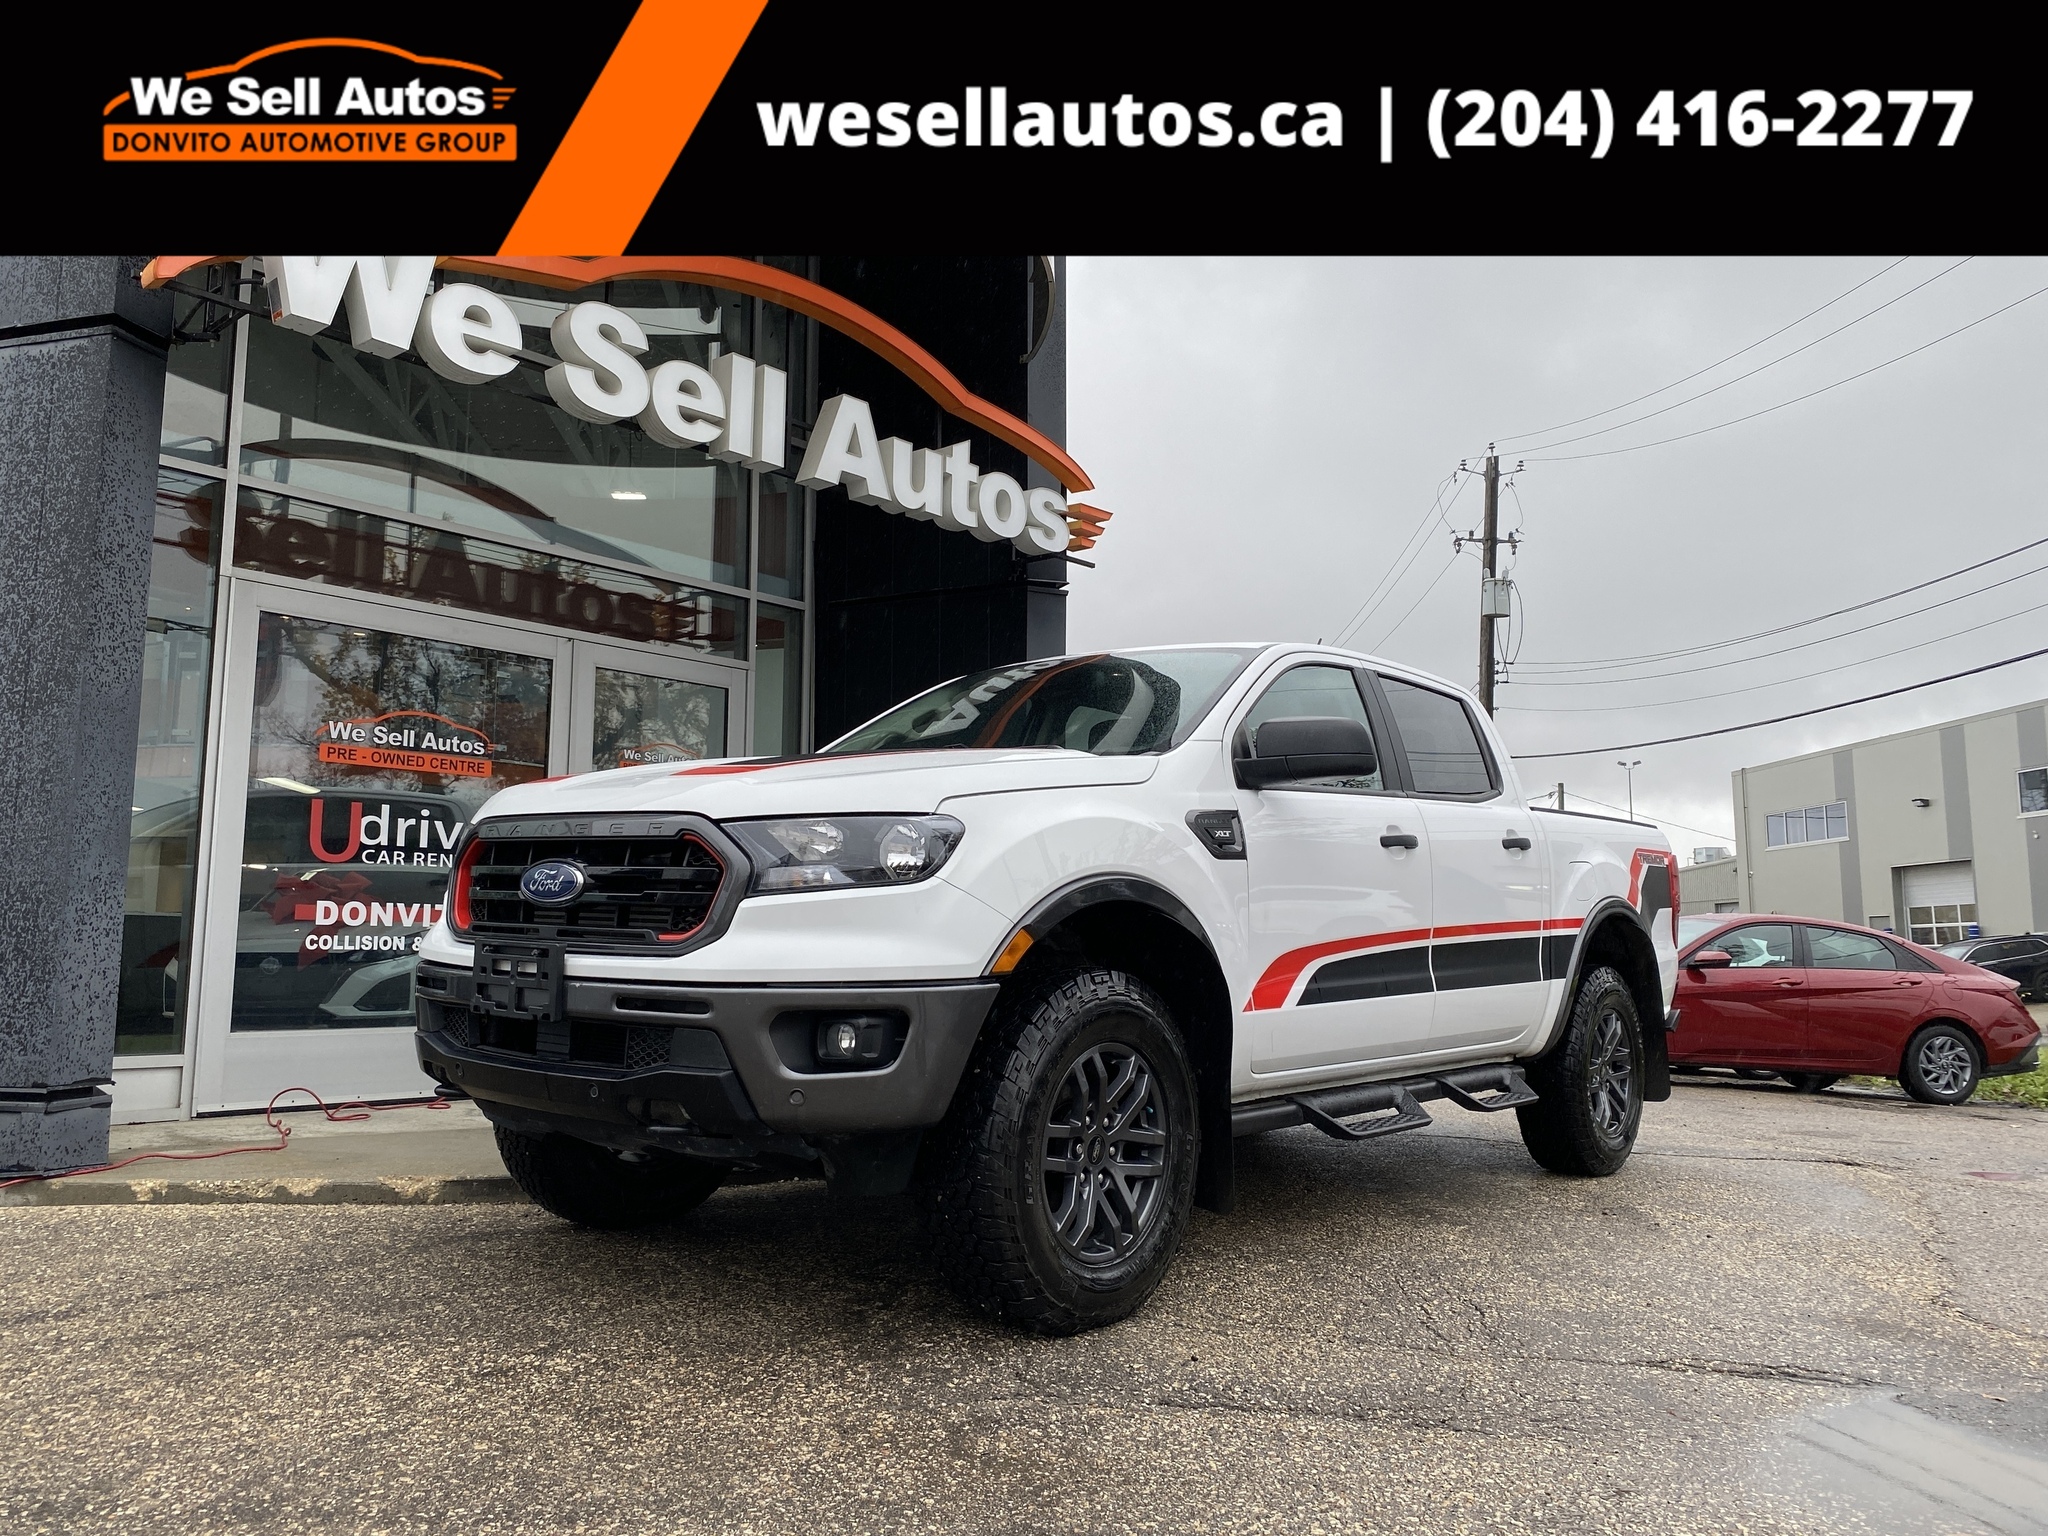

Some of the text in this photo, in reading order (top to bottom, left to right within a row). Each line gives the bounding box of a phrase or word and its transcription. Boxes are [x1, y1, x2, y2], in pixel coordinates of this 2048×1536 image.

[262, 256, 1071, 556] We Sell Autos
[328, 720, 486, 755] We Sell Autos
[326, 746, 358, 761] PRE
[370, 751, 426, 768] OWNED
[429, 757, 486, 774] CENTRE
[623, 749, 691, 763] We Sell Aut
[309, 798, 464, 864] Udriv
[485, 822, 665, 837] RANGER
[1214, 830, 1232, 838] XLT
[361, 849, 456, 868] CAR REN
[529, 868, 565, 892] Ford
[305, 934, 406, 951] COLLISION
